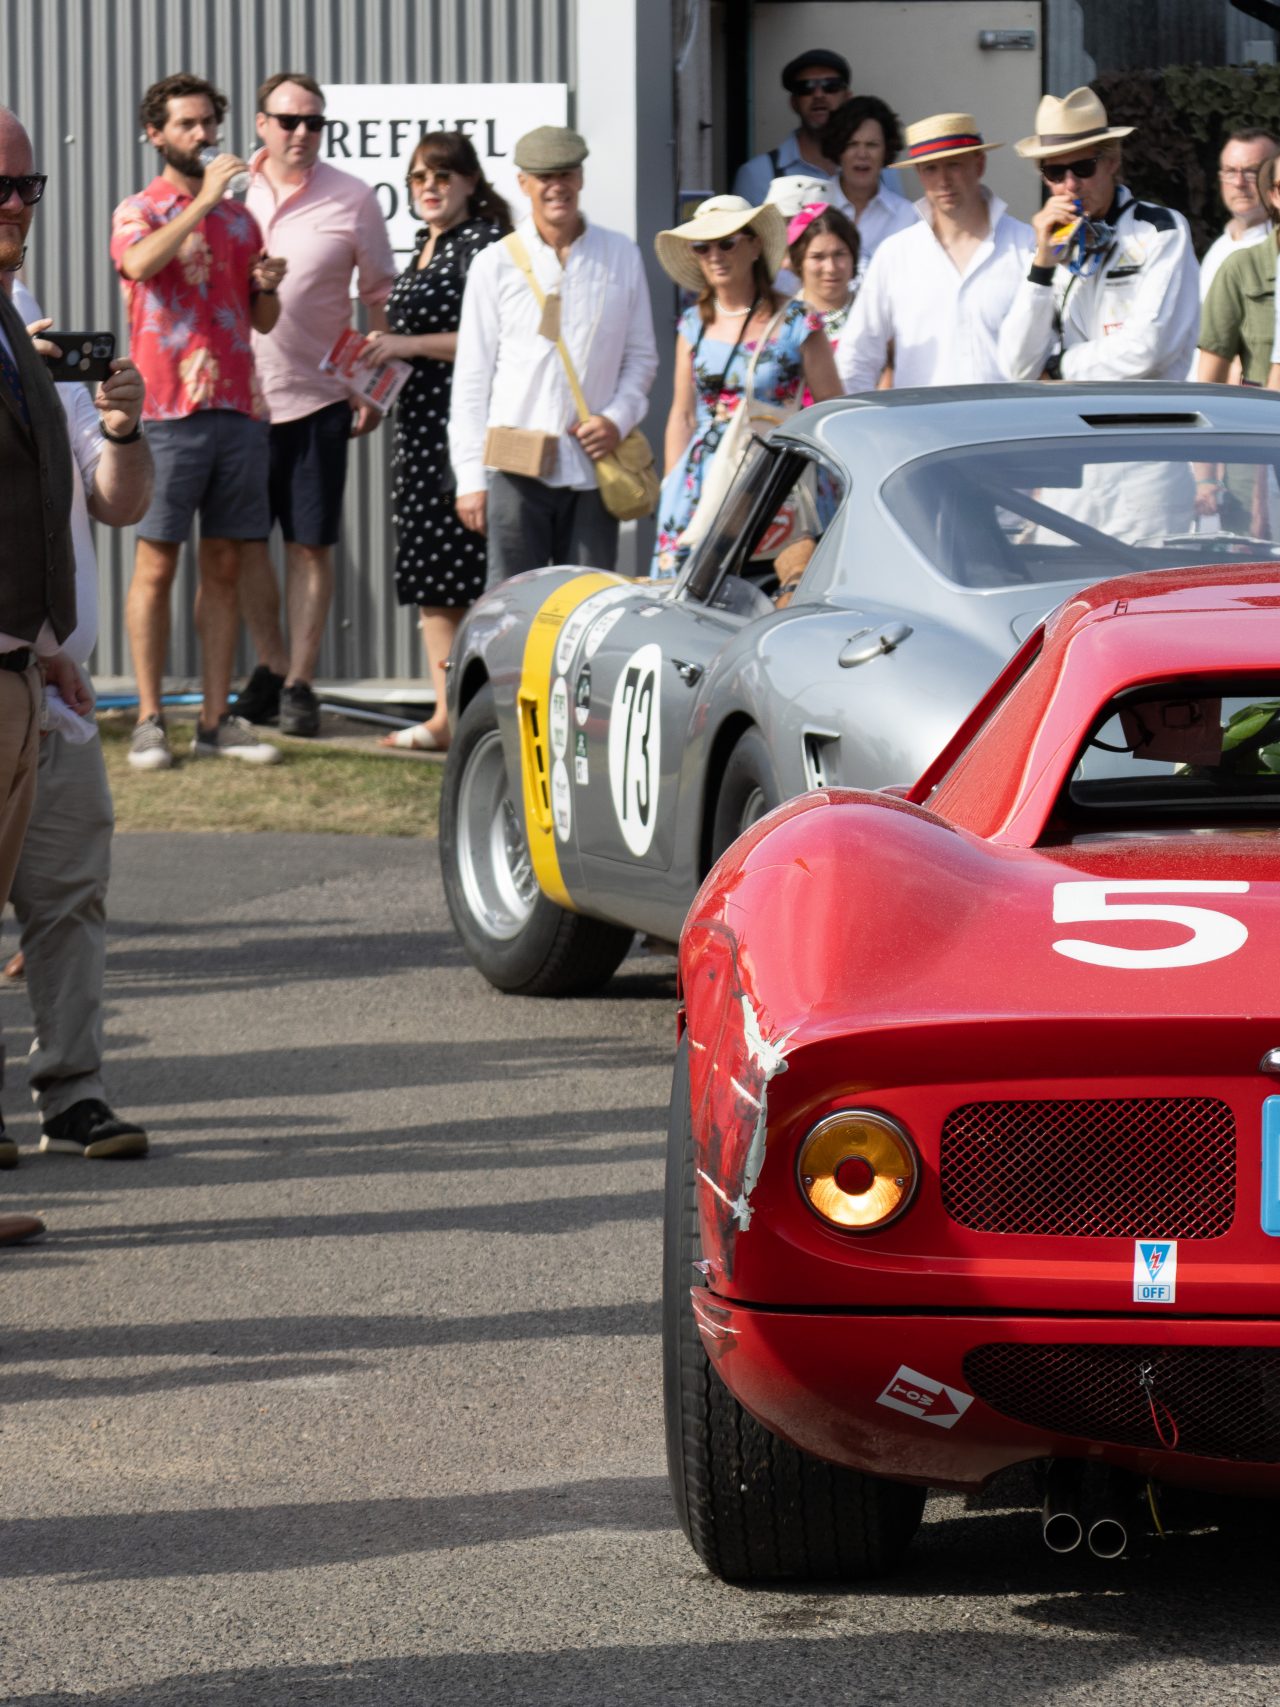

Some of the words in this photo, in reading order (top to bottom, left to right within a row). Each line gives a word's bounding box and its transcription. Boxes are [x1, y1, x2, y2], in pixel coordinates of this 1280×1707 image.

[325, 118, 507, 158] REFL
[622, 667, 655, 826] 73
[1142, 1286, 1165, 1299] OFF
[892, 1384, 935, 1407] TOW
